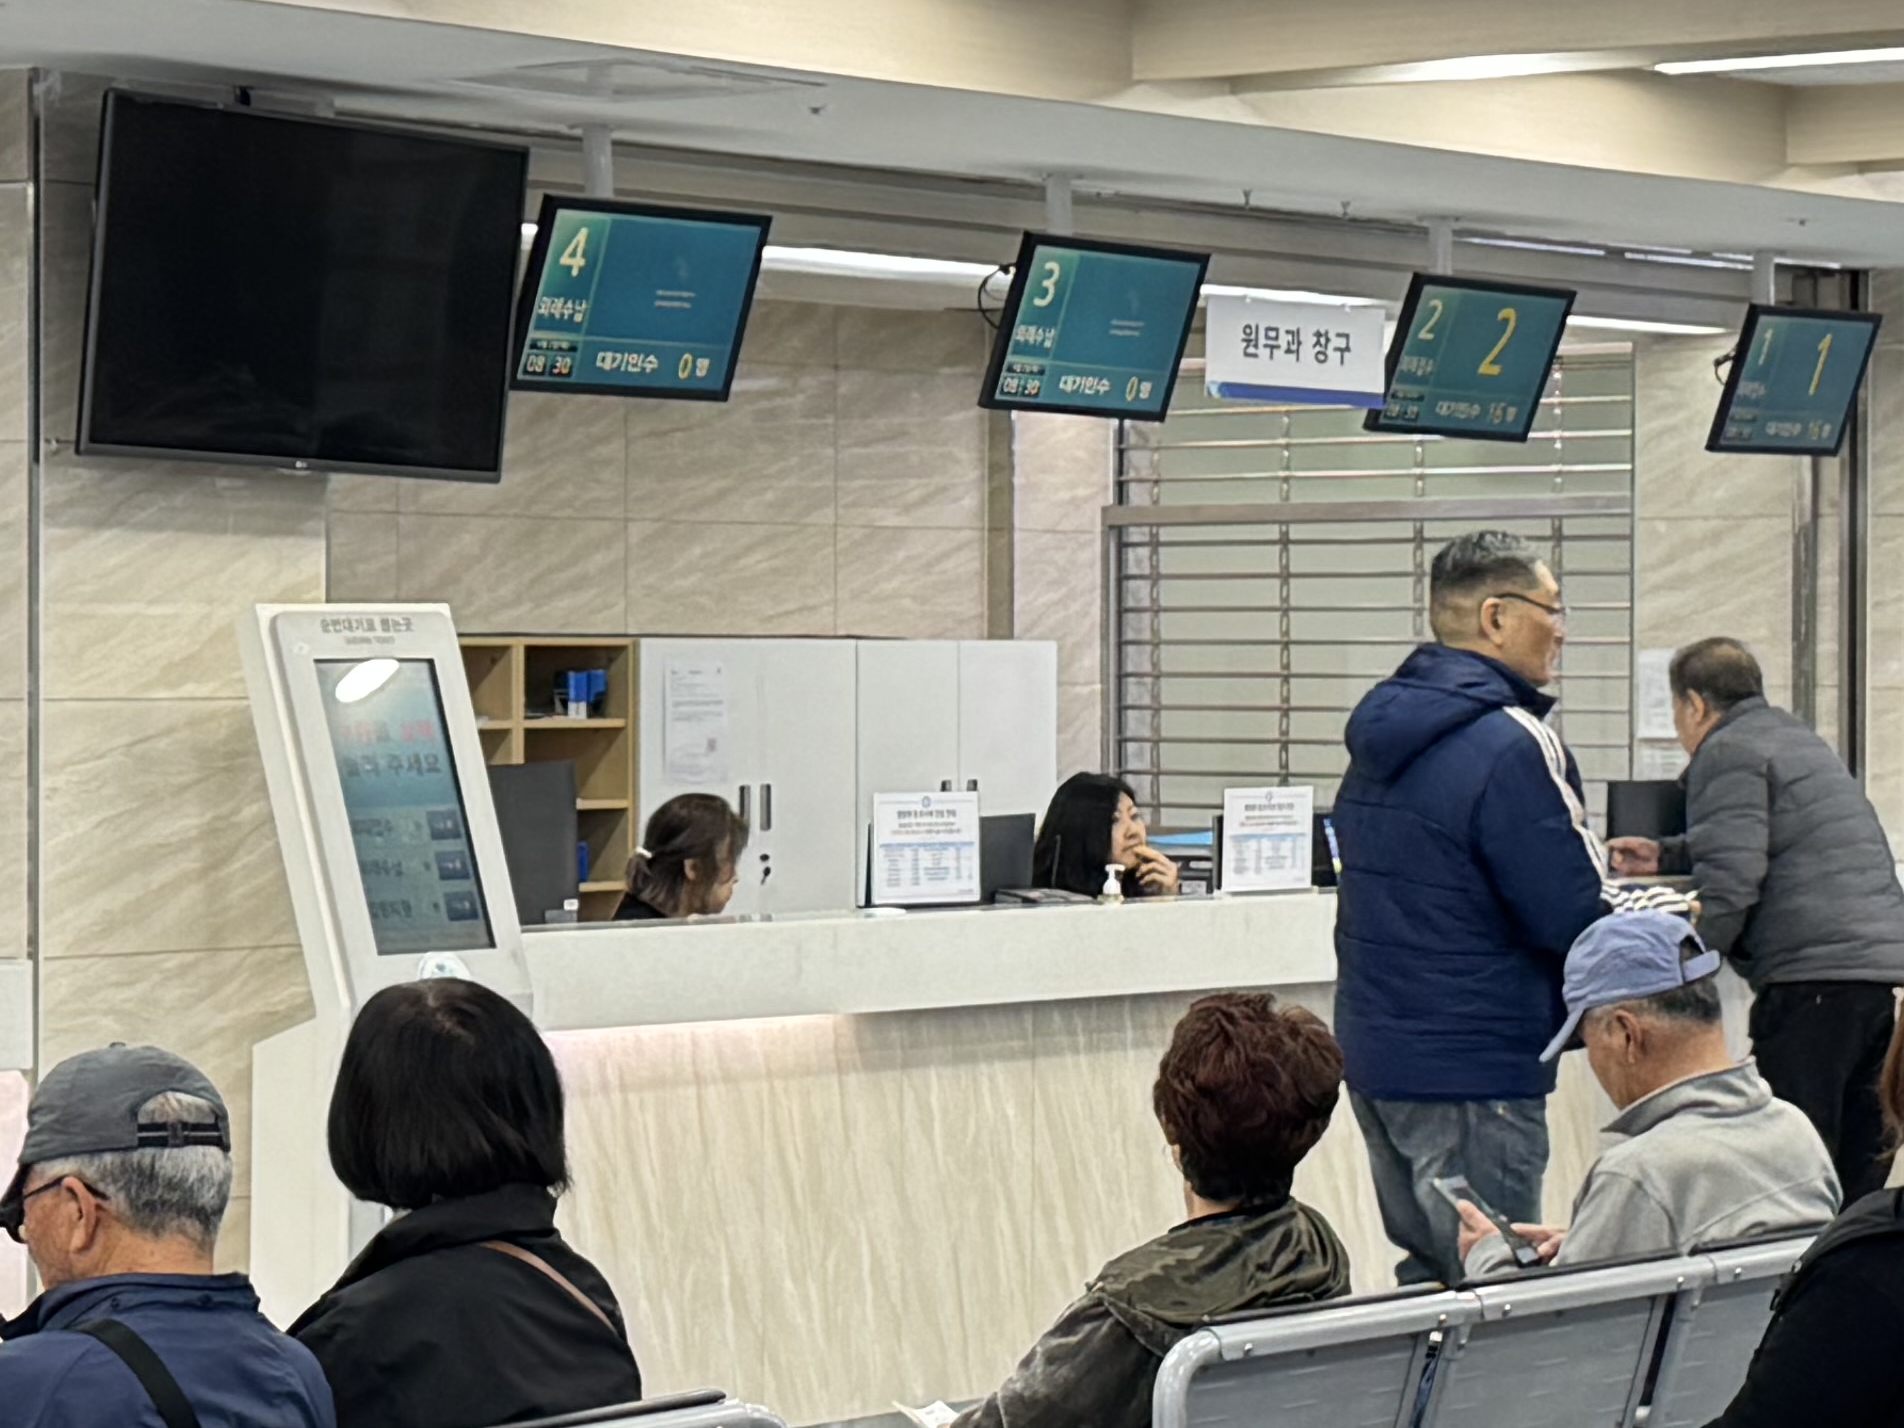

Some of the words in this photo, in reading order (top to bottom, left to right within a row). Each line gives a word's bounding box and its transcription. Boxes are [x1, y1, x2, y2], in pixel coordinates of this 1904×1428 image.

[560, 227, 589, 276] 4
[1033, 261, 1061, 307] 3
[1418, 299, 1443, 341] 2
[1477, 307, 1517, 376] 2
[596, 351, 658, 373] 대기인수
[678, 353, 693, 380] 0
[1241, 323, 1302, 363] 원무과
[1312, 328, 1352, 366] 창구
[1758, 328, 1773, 366] 1
[1808, 333, 1833, 396] 1
[1059, 375, 1111, 395] 대기인수
